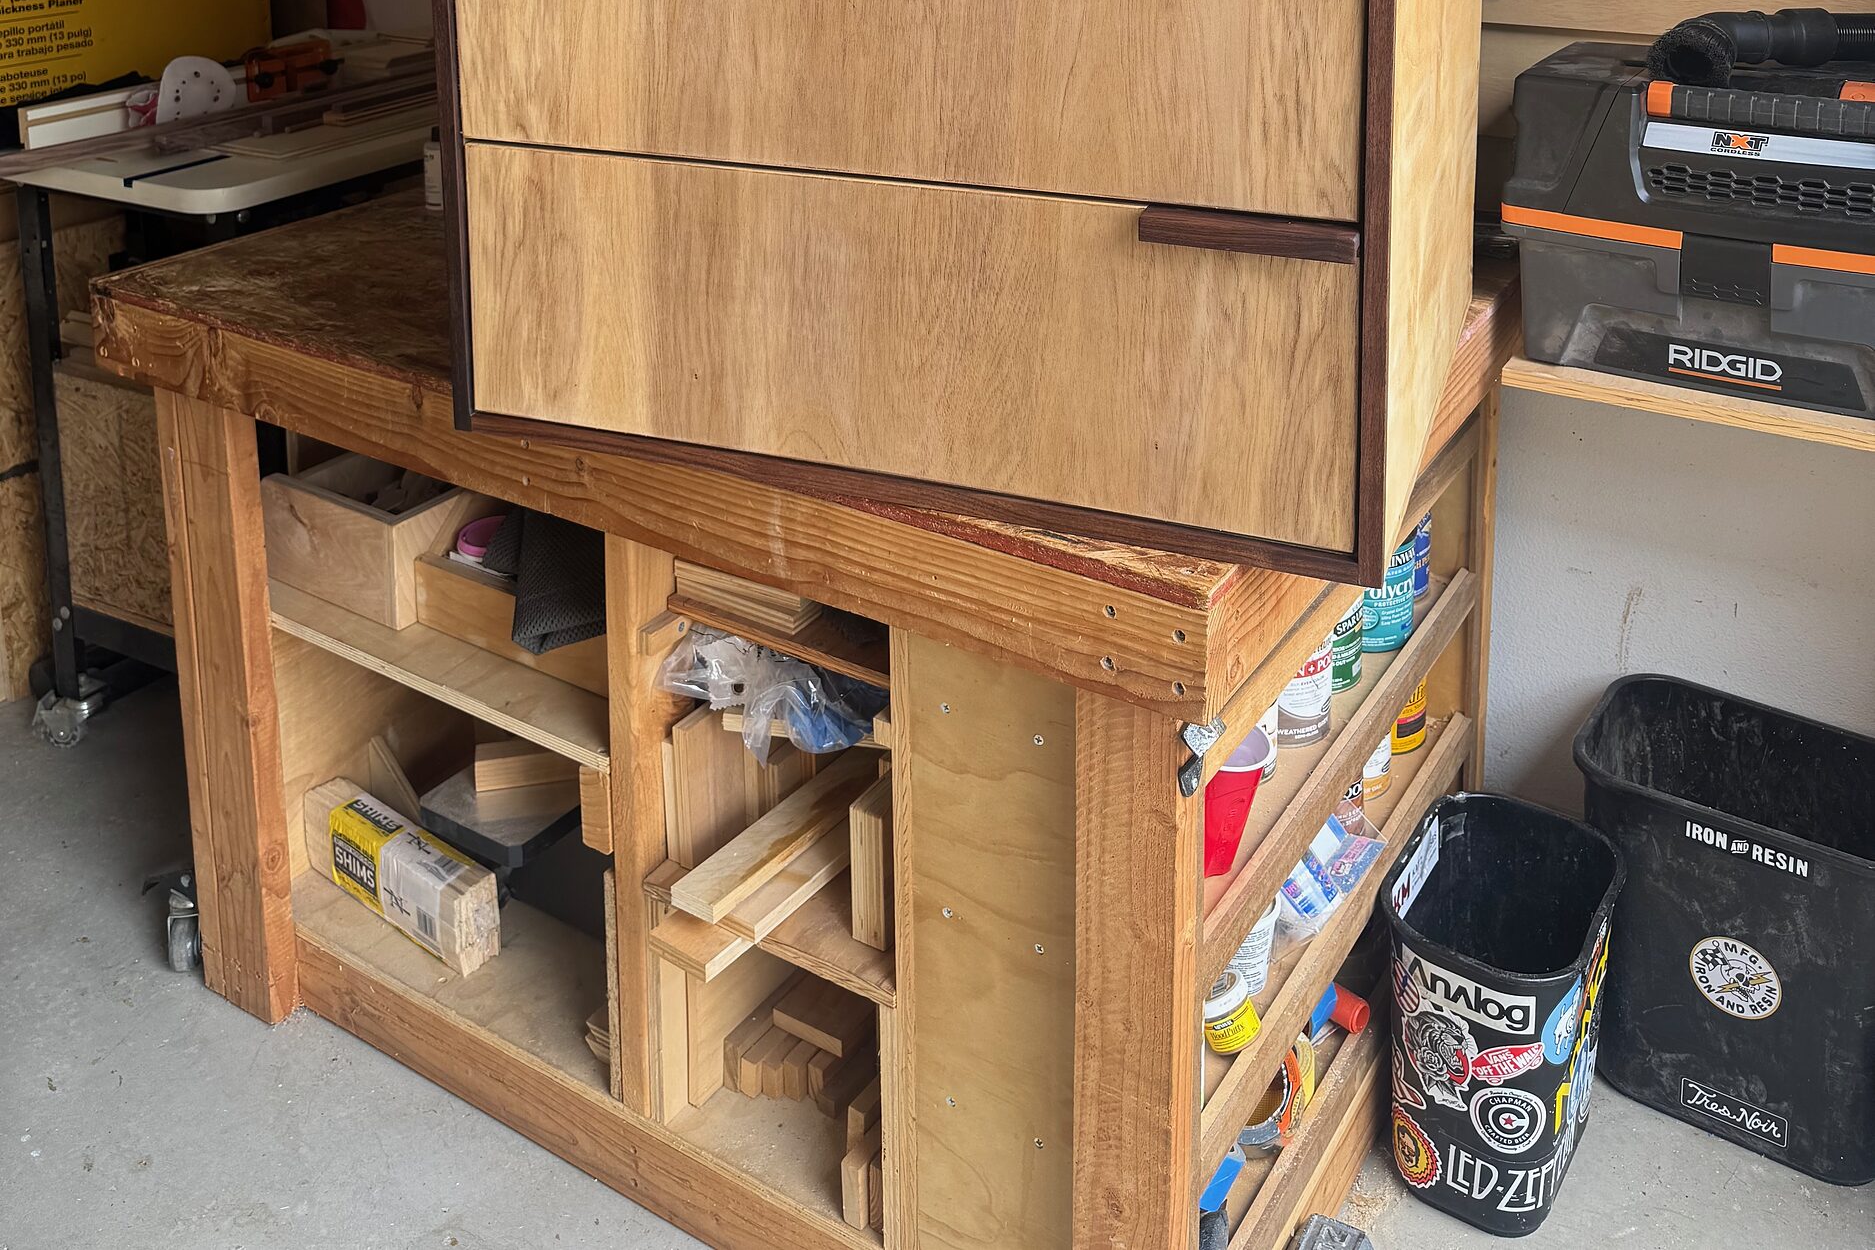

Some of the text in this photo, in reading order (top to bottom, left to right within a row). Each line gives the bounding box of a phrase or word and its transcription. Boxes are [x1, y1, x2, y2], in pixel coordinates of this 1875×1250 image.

[0, 3, 45, 15] ickness
[5, 36, 24, 48] 330
[27, 34, 47, 45] mm
[50, 32, 65, 44] (13
[17, 44, 54, 58] trabajo
[57, 38, 94, 53] pesado
[9, 80, 28, 91] 330
[30, 77, 50, 88] mm
[1711, 131, 1769, 152] NXT
[1710, 148, 1761, 157] CORDLESS
[1668, 343, 1783, 382] RIDGID
[353, 799, 398, 830] SHIMS
[1685, 820, 1808, 877] IRON AND RESIN
[335, 846, 375, 888] SHIMS
[1723, 941, 1763, 970] MFG.
[1694, 961, 1777, 1015] IRON AND RESIN
[1483, 1049, 1515, 1065] VANS
[1494, 1059, 1519, 1076] THE
[1489, 1096, 1533, 1112] CHAPMAN
[1687, 1083, 1781, 1138] Tres Noir
[1484, 1123, 1513, 1145] CRAFTED
[1514, 1132, 1530, 1144] BEER
